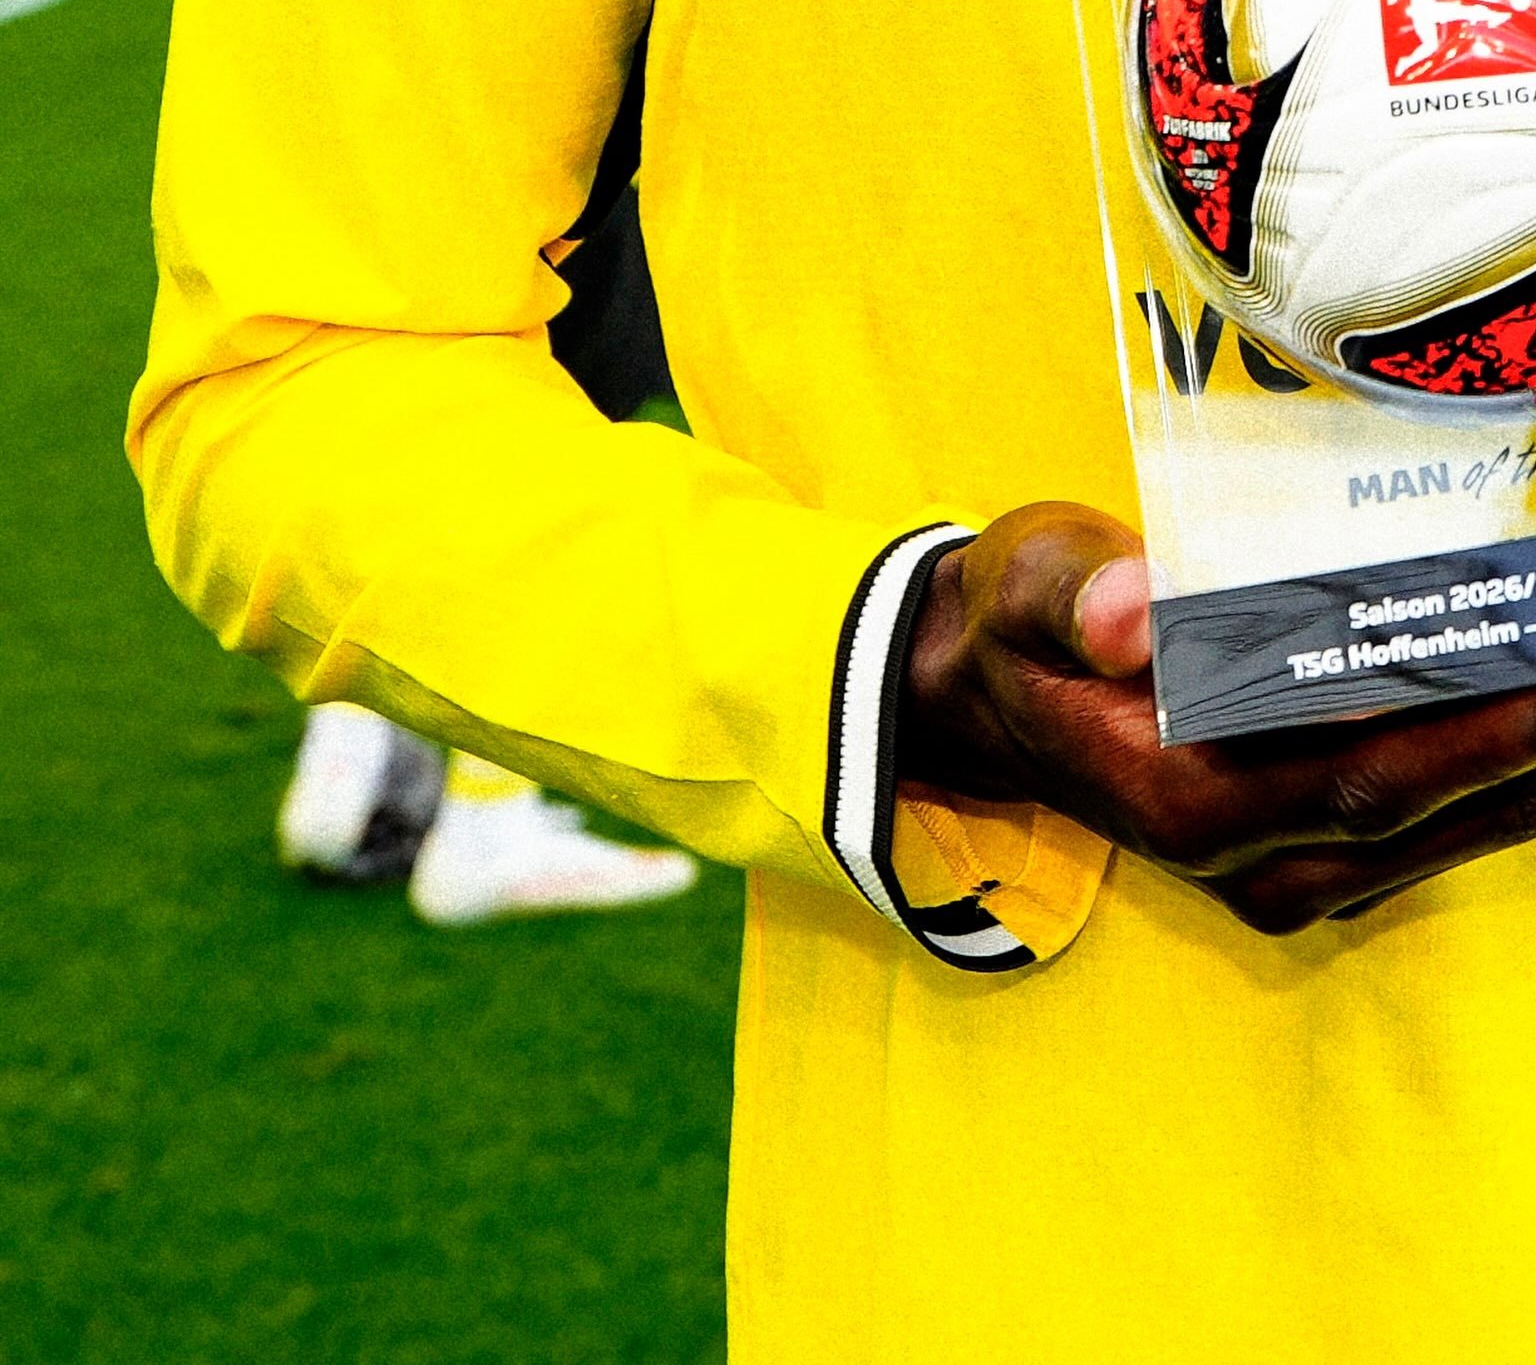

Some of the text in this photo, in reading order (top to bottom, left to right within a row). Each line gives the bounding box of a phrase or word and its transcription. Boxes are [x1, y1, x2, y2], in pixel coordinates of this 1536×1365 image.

[1348, 463, 1452, 508] MAN
[1462, 446, 1511, 499] of
[1348, 593, 1446, 630] Saison
[1287, 647, 1345, 680] TSG
[1347, 620, 1520, 670] Hoffenheim
